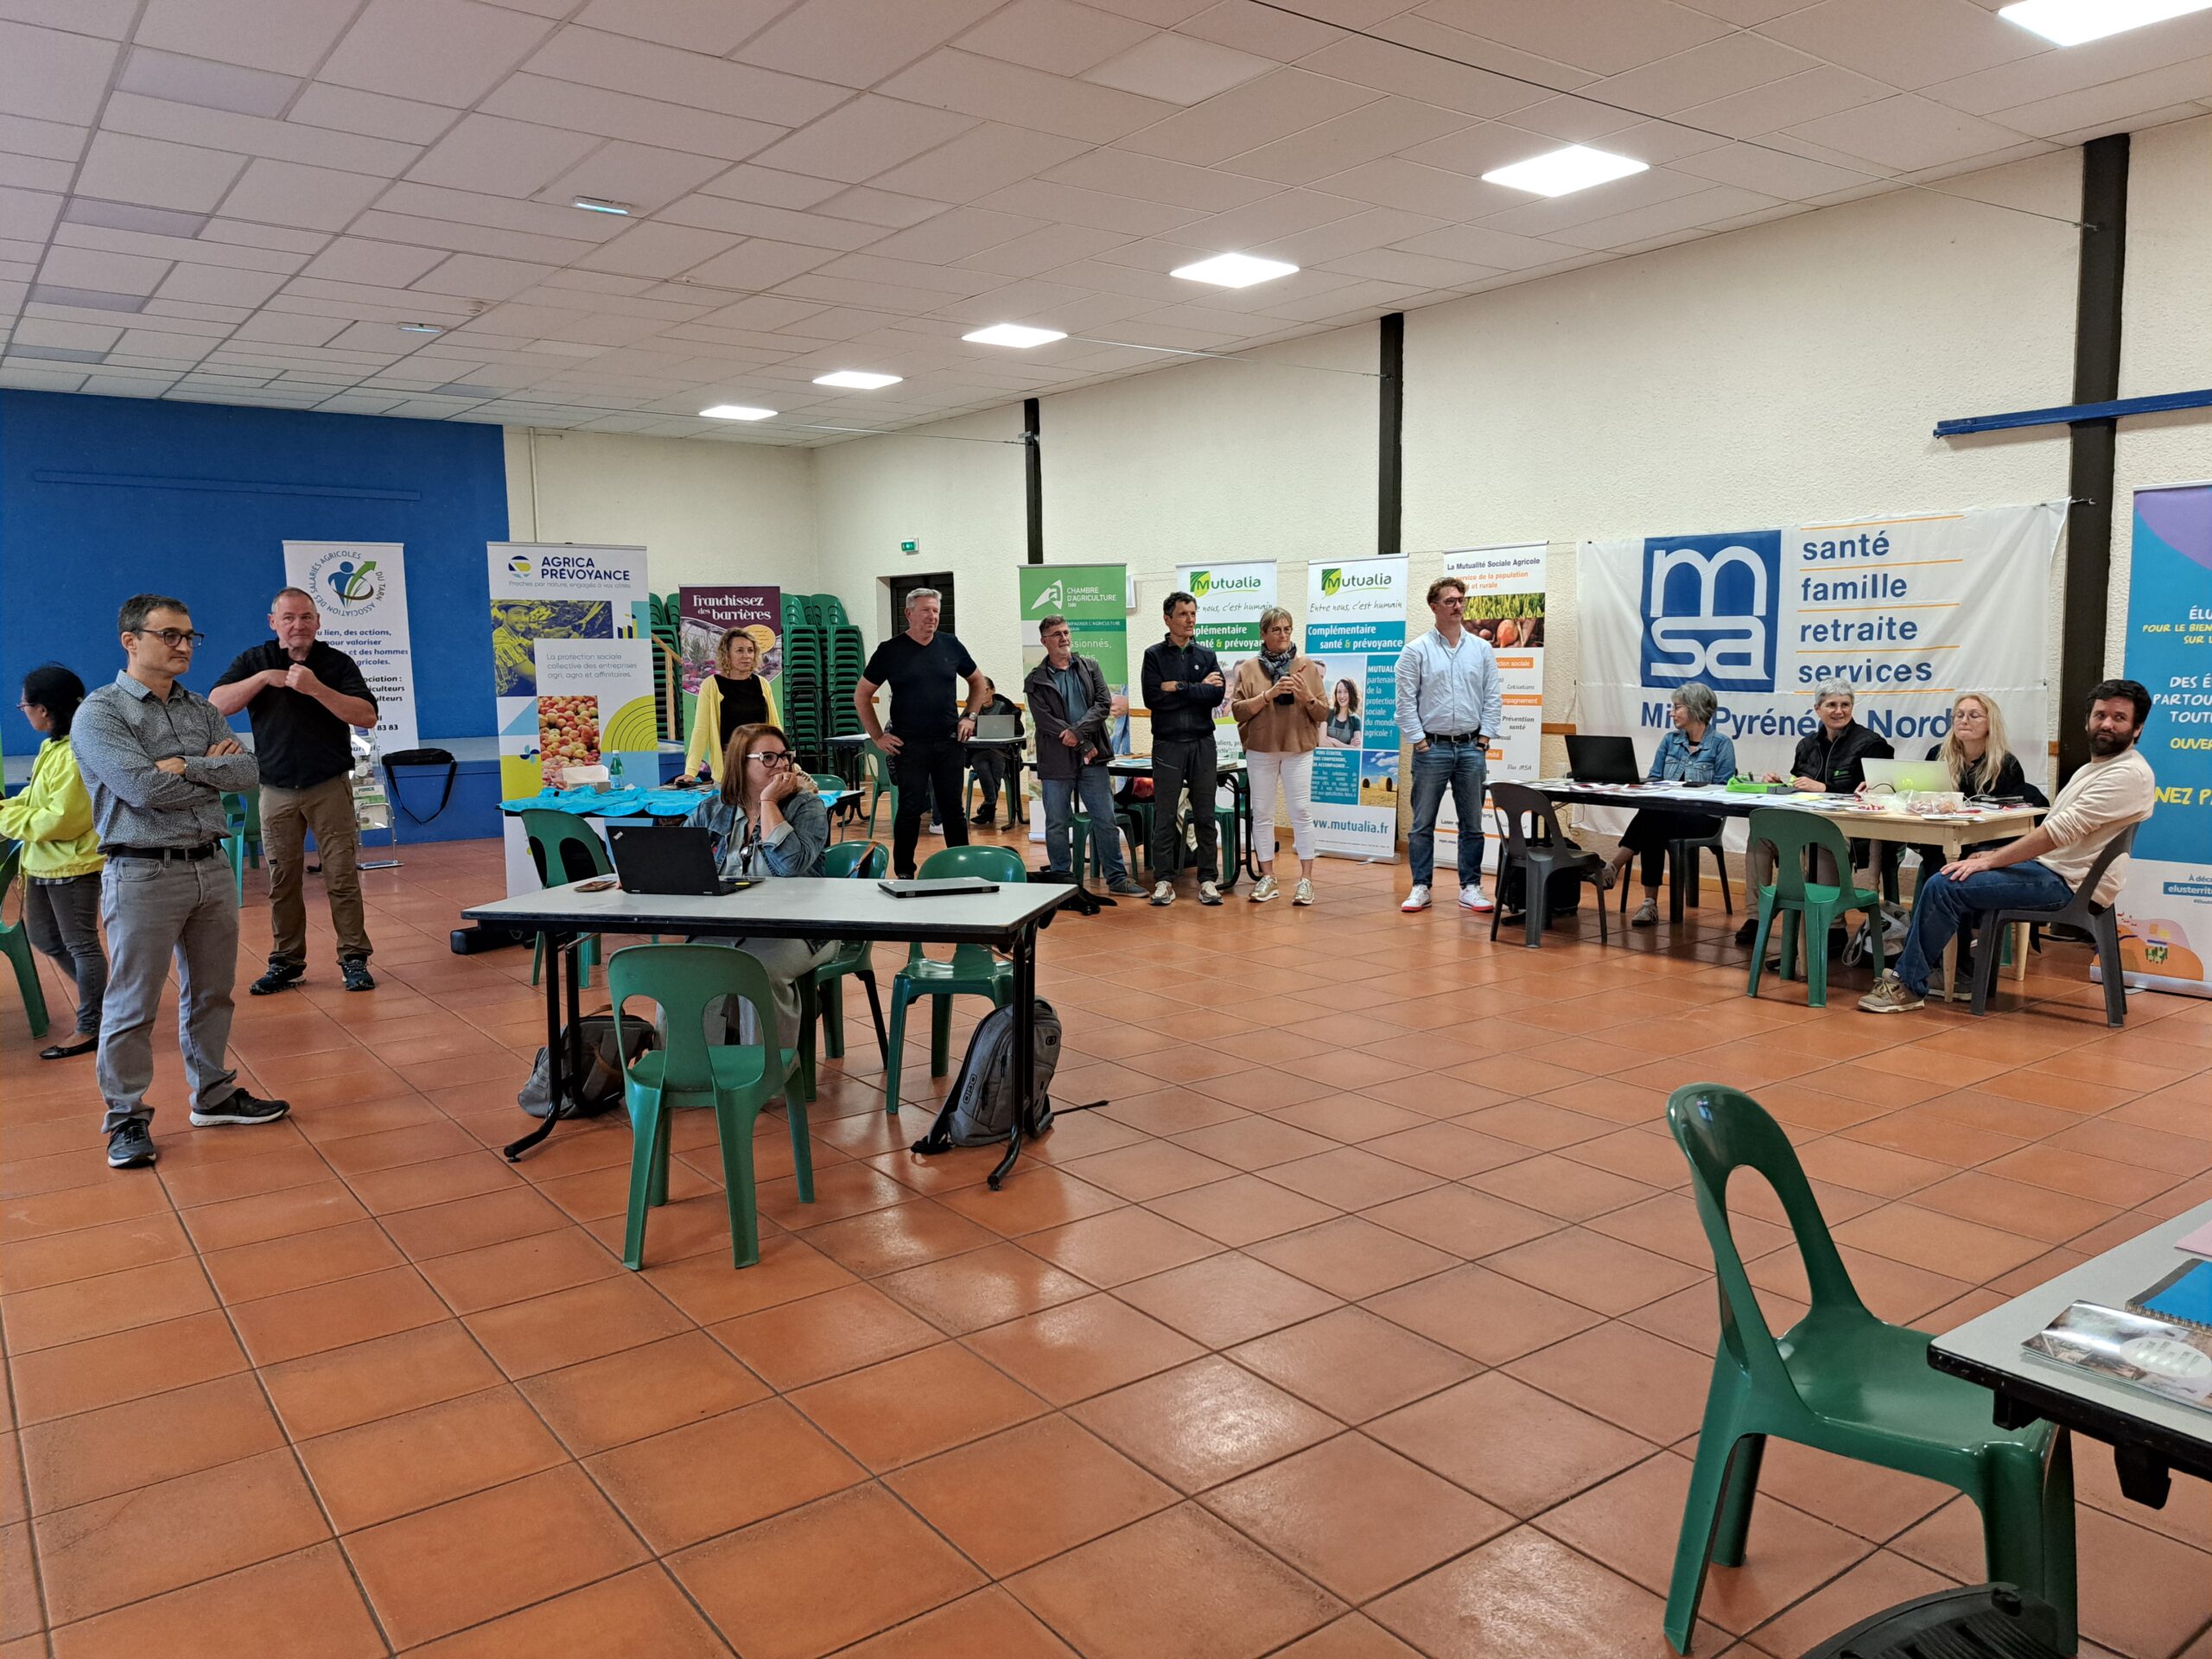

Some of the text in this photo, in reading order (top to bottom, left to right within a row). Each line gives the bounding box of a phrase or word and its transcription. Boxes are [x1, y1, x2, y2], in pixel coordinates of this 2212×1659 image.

[1802, 530, 1890, 561] santé
[321, 550, 362, 564] AGRICOLES
[541, 556, 595, 568] AGRICA
[1456, 562, 1486, 570] Mutualité
[1487, 559, 1511, 568] Sociale
[1512, 557, 1541, 567] Agricole
[375, 570, 385, 582] DU
[541, 568, 631, 581] PRÉVOYANCE
[1327, 573, 1392, 588] Mutualia
[1495, 571, 1529, 580] population
[1197, 575, 1261, 590] Mutualia
[1802, 573, 1908, 601] famille
[375, 582, 386, 601] TARN
[314, 594, 327, 607] DES
[693, 594, 765, 607] Franchissez
[1309, 603, 1331, 613] Entre
[1373, 599, 1402, 609] humain
[327, 602, 376, 617] ASSOCIATION
[712, 608, 772, 620] barrières
[359, 628, 391, 637] actions,
[1193, 625, 1248, 638] plémentaire
[1307, 624, 1376, 638] Complémentaire
[1800, 616, 1918, 642] retraite
[2142, 624, 2171, 633] POUR
[2174, 623, 2186, 632] LE
[1071, 638, 1112, 649] ssionnés,
[1217, 639, 1223, 648] &
[1319, 639, 1403, 651] santé & prévoyance
[2183, 634, 2205, 645] SUR
[356, 658, 391, 668] gricoles.
[598, 662, 638, 671] entreprises
[1367, 664, 1395, 673] MUTUAL
[1798, 658, 1933, 683] services
[2170, 676, 2198, 689] DES
[1366, 686, 1382, 695] de la
[1365, 708, 1387, 716] sociale
[1867, 708, 1953, 739] Nord
[1364, 728, 1389, 738] agricole
[2154, 786, 2193, 805] NEZ
